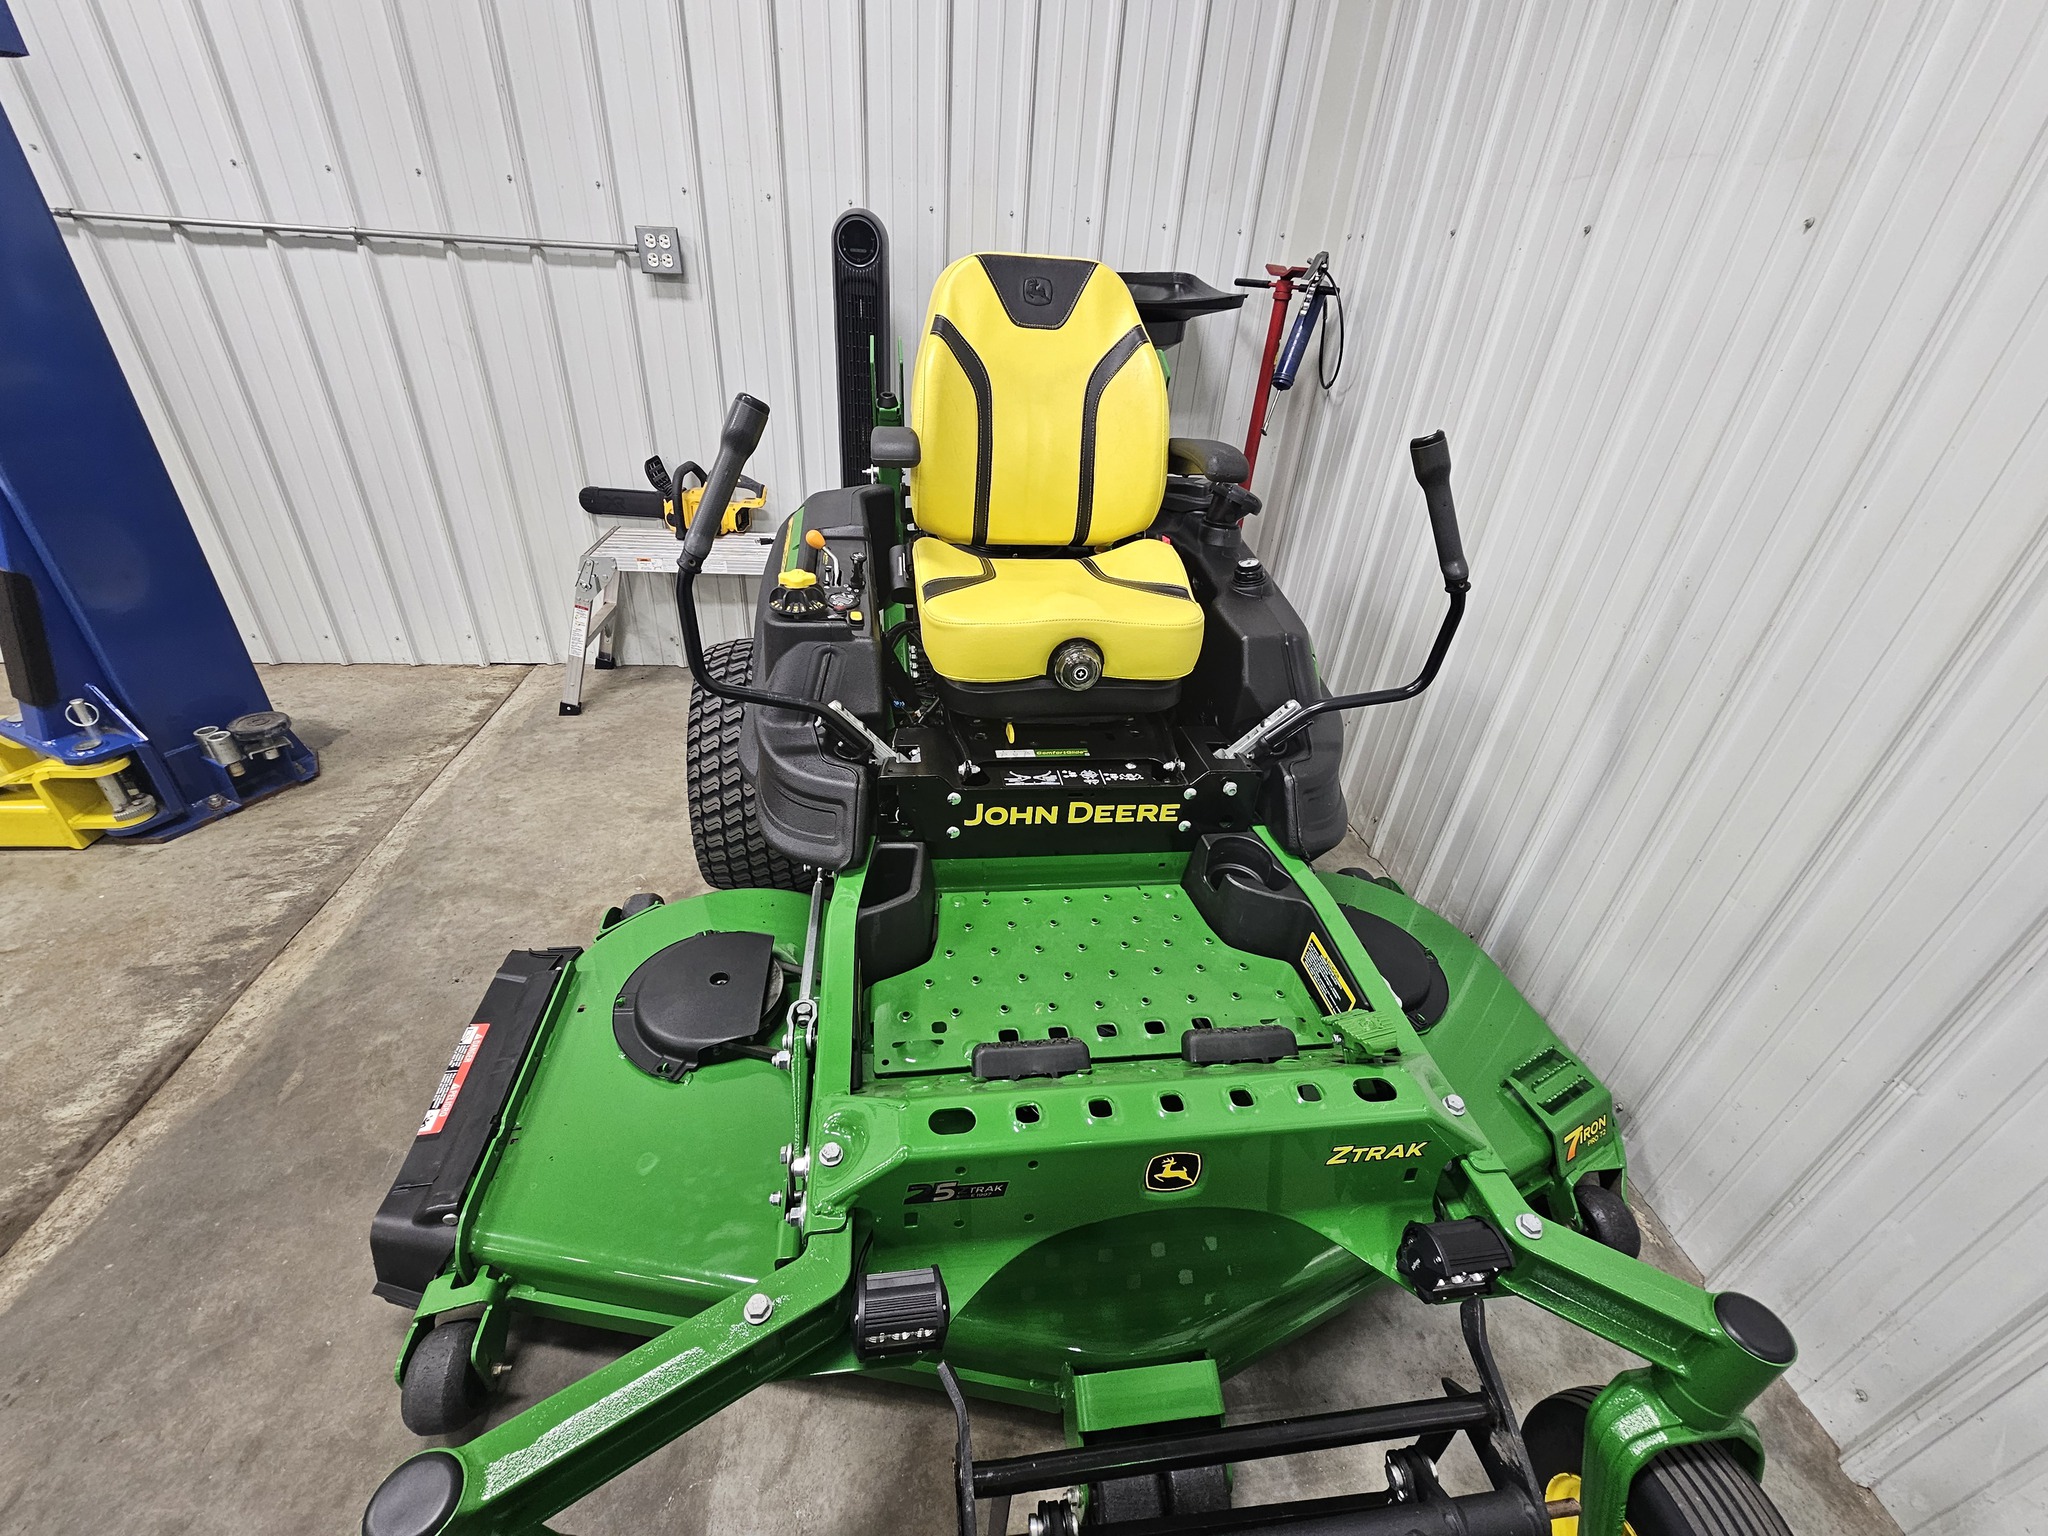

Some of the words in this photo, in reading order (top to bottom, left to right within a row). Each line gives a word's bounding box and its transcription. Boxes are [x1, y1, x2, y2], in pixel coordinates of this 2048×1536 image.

[963, 803, 1059, 826] JOHN
[1067, 801, 1181, 824] DEERE
[1325, 1141, 1429, 1166] ZTRAK
